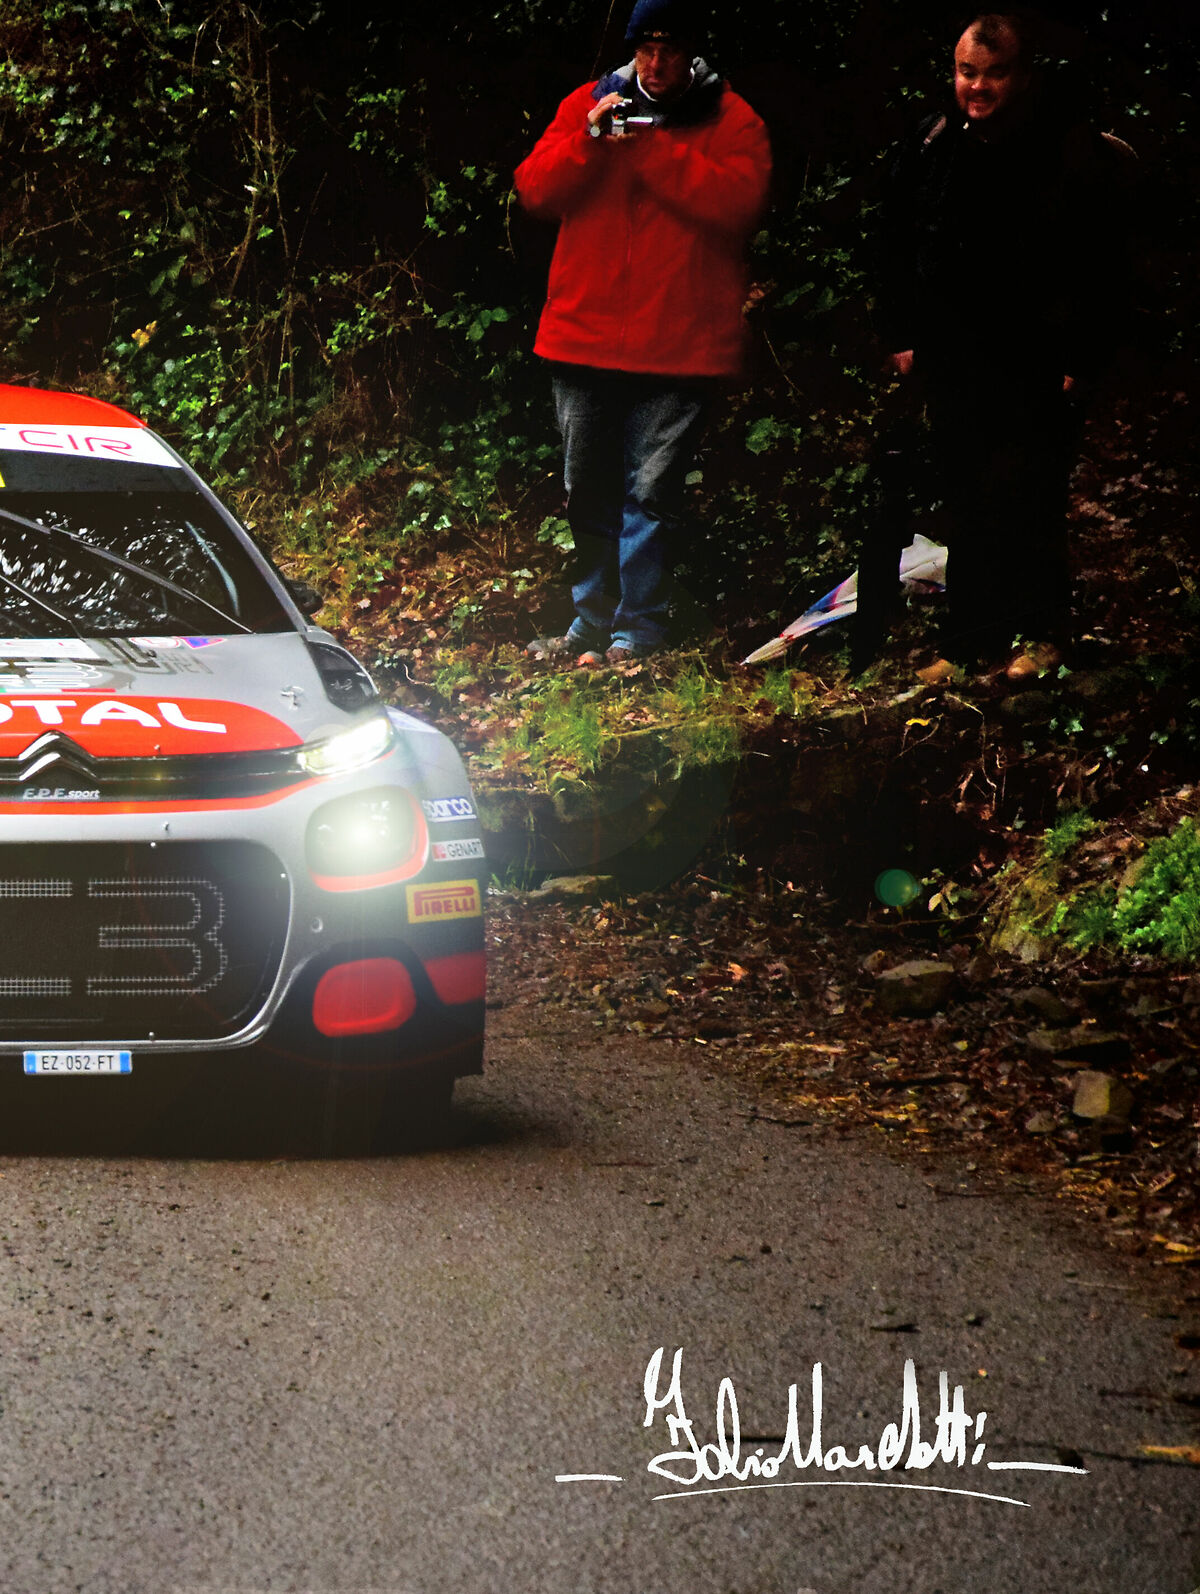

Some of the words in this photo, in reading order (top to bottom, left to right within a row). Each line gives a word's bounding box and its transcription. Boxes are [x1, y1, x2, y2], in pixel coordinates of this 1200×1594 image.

[18, 430, 133, 456] CIR
[413, 886, 476, 917] PIRELLI
[41, 1055, 58, 1070] EZ
[66, 1055, 91, 1070] 052
[98, 1055, 114, 1070] FT
